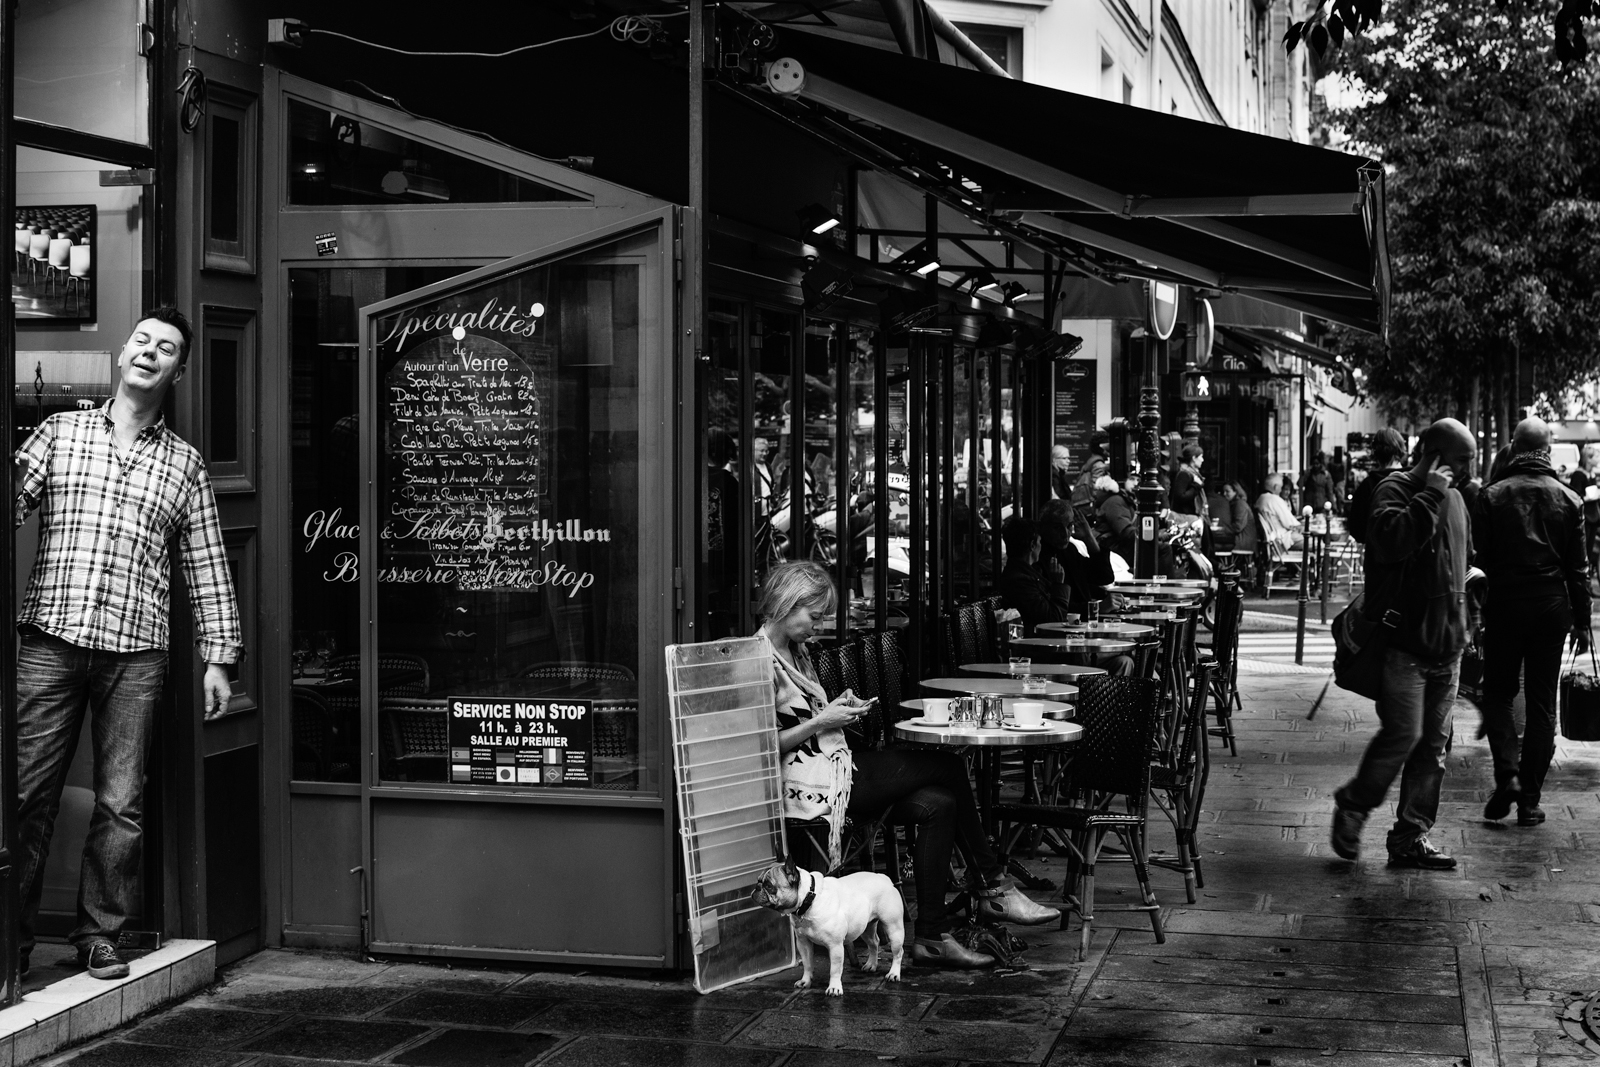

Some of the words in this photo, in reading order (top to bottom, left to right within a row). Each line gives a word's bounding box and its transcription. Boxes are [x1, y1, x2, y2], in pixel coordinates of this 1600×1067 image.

[403, 360, 436, 372] Autour
[437, 360, 459, 372] d'un
[303, 506, 360, 554] Glac
[379, 525, 392, 540] &
[530, 560, 595, 599] Stop
[453, 701, 512, 719] SERVICE
[514, 702, 546, 719] NON
[549, 703, 587, 720] STOP
[479, 721, 493, 733] 11
[496, 721, 508, 733] h.
[514, 721, 523, 734] à
[528, 721, 544, 734] 23
[546, 722, 559, 734] h.
[470, 735, 502, 746] SALLE
[504, 736, 519, 747] AU
[522, 736, 569, 748] PREMIER
